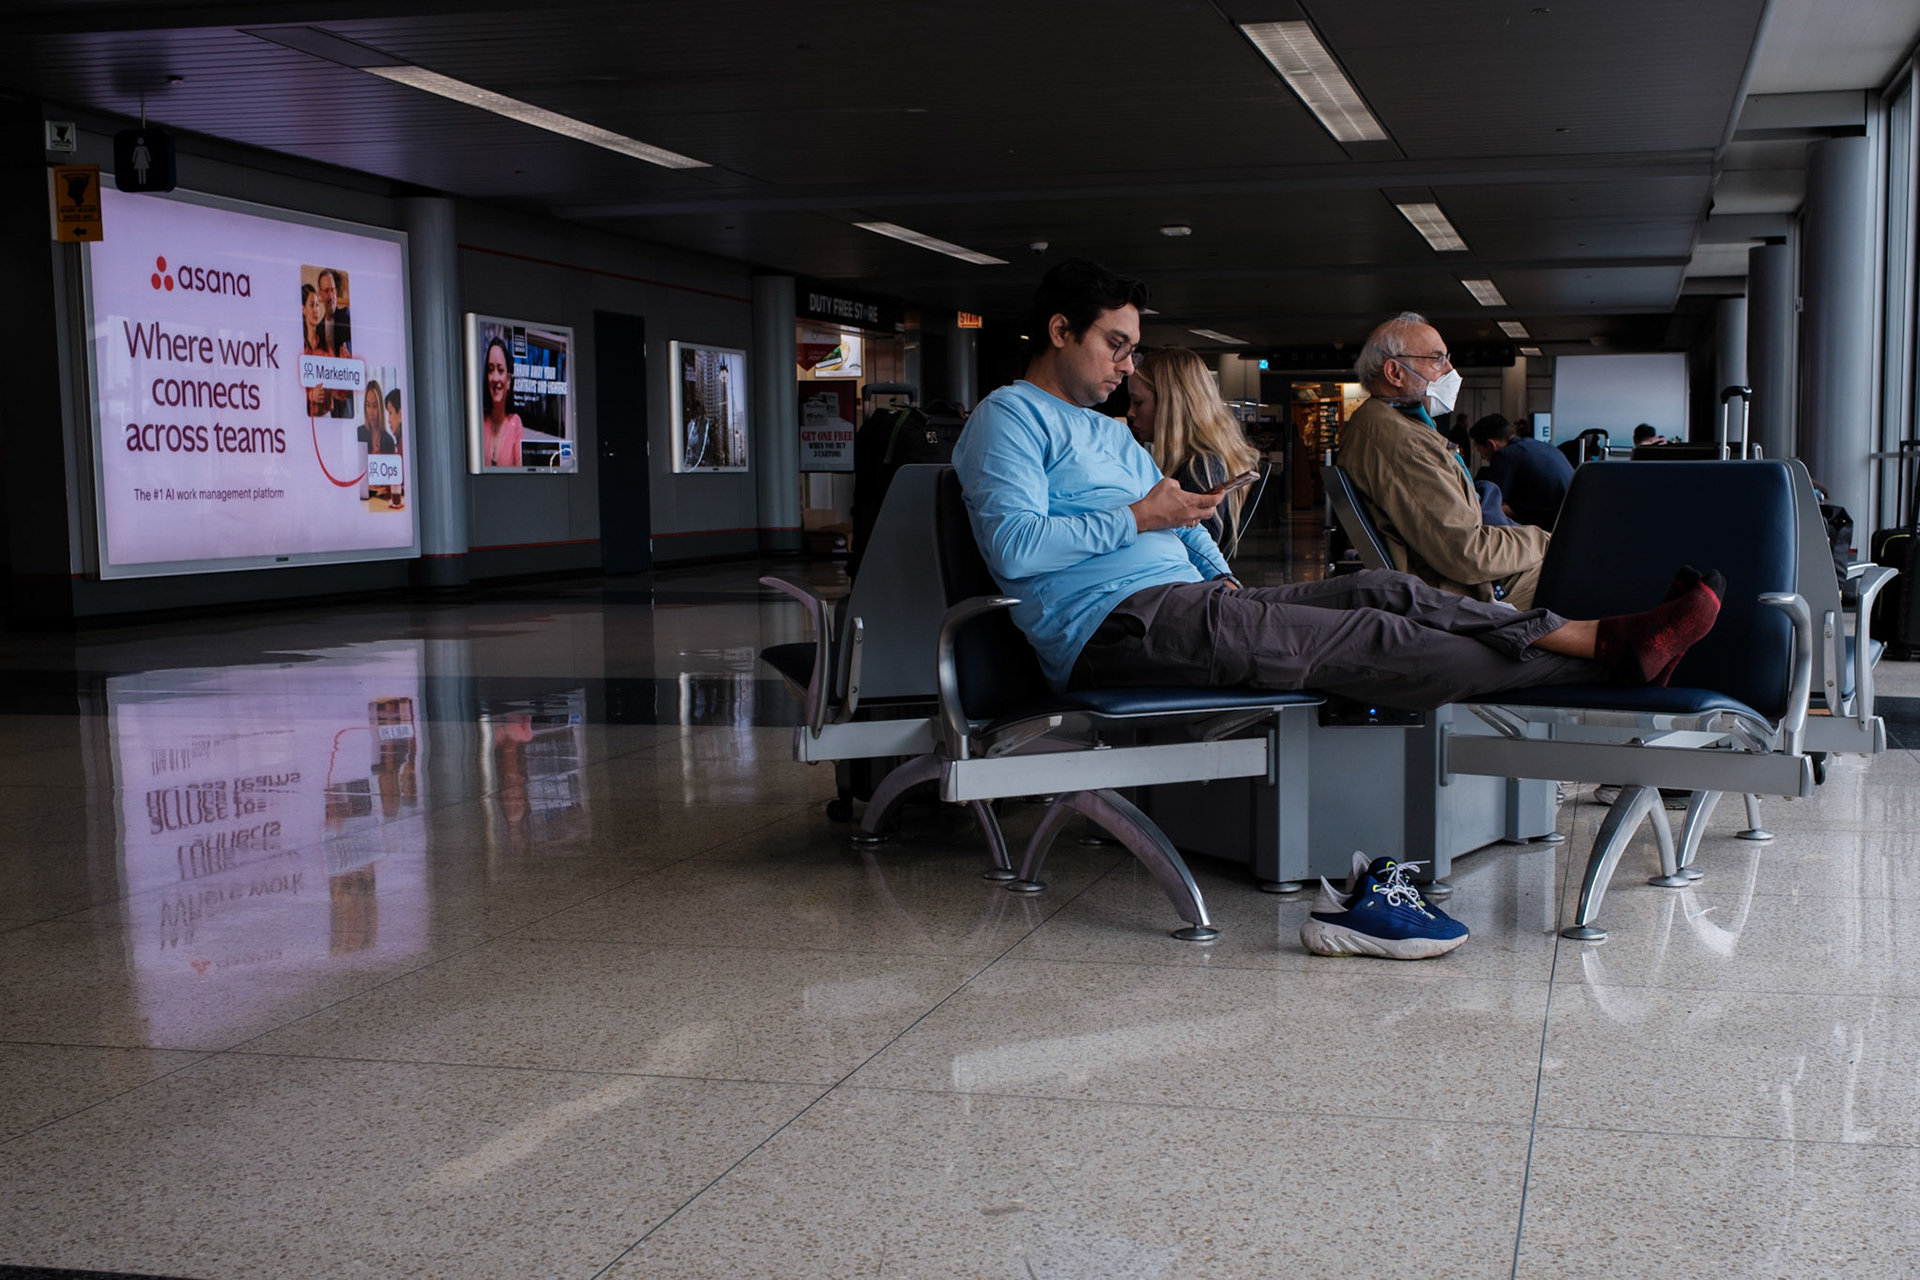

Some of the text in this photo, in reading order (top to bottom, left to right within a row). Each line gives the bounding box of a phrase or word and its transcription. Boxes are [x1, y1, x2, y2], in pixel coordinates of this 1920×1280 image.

[178, 265, 251, 298] asana
[809, 292, 833, 315] DUTY
[833, 297, 853, 319] FREE
[122, 320, 280, 371] Where work
[315, 364, 360, 386] Marketing
[151, 377, 261, 411] connects
[125, 421, 287, 455] across teams
[802, 430, 853, 442] GET ONE FREE
[379, 462, 398, 480] Ops
[134, 486, 285, 504] The #1 AI work management platform
